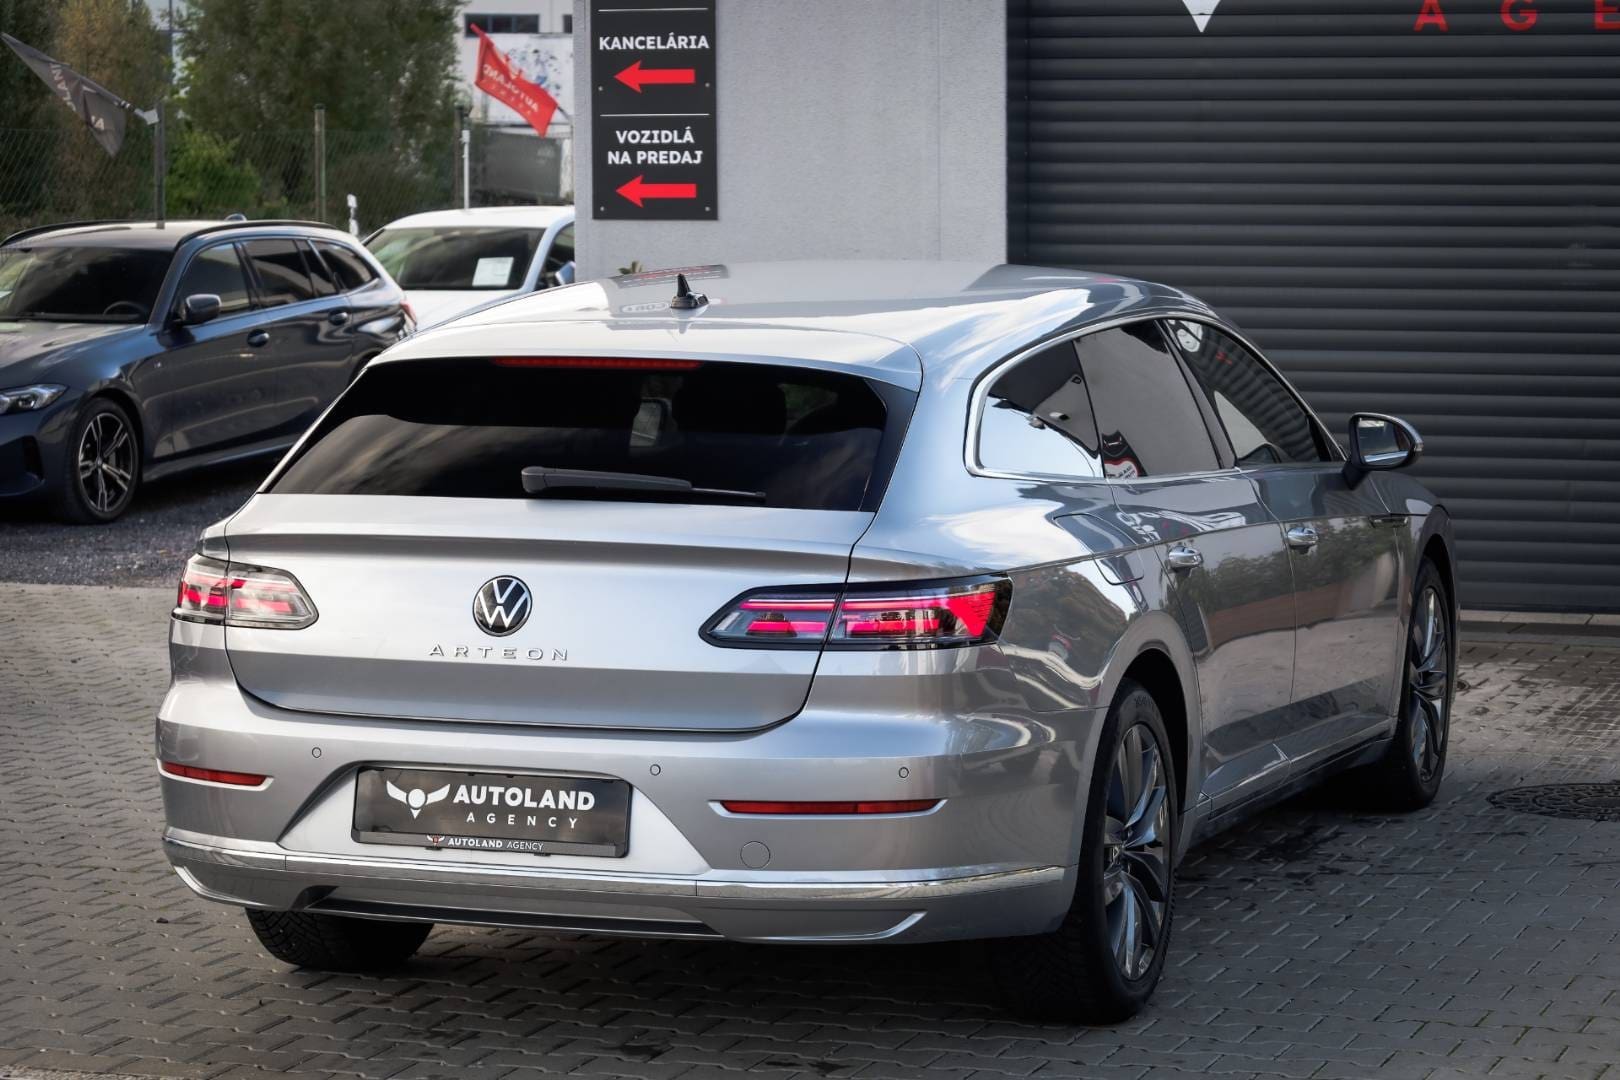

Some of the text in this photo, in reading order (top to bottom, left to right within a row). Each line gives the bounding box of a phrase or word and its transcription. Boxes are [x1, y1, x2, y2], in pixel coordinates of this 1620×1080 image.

[599, 32, 710, 51] KANCELÁRIA
[615, 126, 695, 144] VOZIDLÁ
[607, 150, 704, 165] NA PREDAJ
[428, 643, 569, 662] ARTEON
[453, 784, 595, 811] AUTOLAND
[466, 811, 578, 829] AGENCY
[448, 837, 544, 851] AUTOLAND AGENCY
